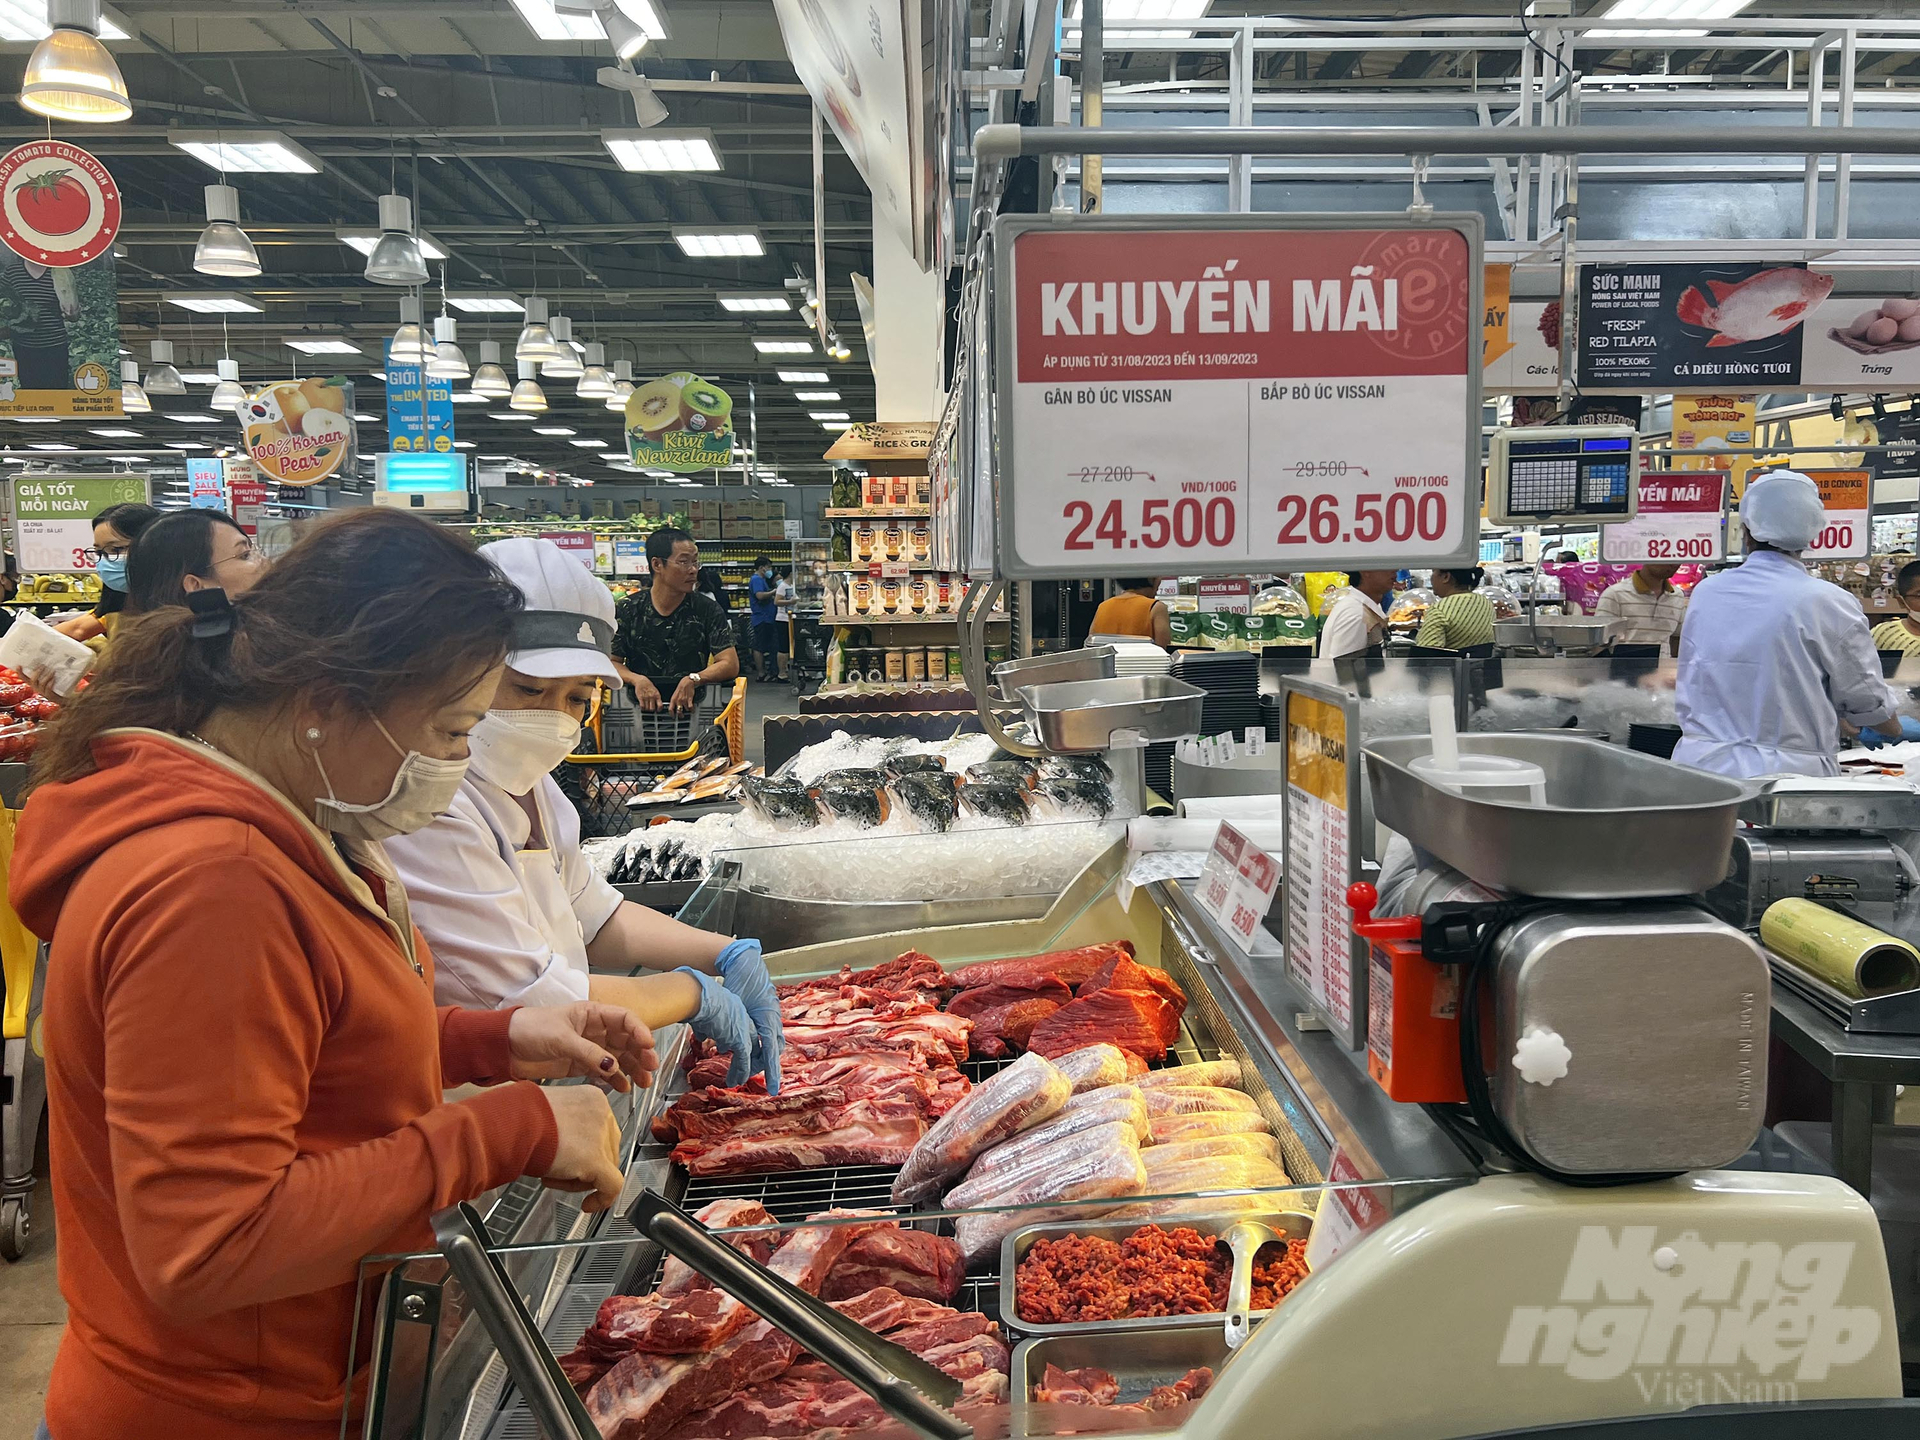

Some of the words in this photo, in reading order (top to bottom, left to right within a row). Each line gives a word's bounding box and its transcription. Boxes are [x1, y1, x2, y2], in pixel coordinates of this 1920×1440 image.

[12, 145, 51, 163] TOMATO
[56, 147, 109, 186] COLLECTION
[1592, 273, 1619, 290] SỨC
[1623, 275, 1660, 291] MẠNH
[1041, 260, 1270, 337] KHUYẾN
[1292, 265, 1398, 332] MÃI
[1589, 337, 1609, 347] RED
[1612, 336, 1657, 347] TILAPIA
[1043, 354, 1057, 368] ÁP
[1060, 355, 1090, 371] DỤNG
[1093, 352, 1107, 367] TỪ
[1111, 354, 1171, 367] 31/08/2023
[1174, 351, 1195, 366] ĐẾN
[1198, 353, 1258, 366] 13/09/2023
[1595, 358, 1616, 367] 100%
[1618, 357, 1650, 366] MEKONG
[1674, 362, 1689, 375] CÁ
[1693, 362, 1722, 375] DIÊU
[1725, 360, 1759, 375] HỒNG
[1763, 362, 1792, 374] TƯƠI
[1860, 364, 1893, 375] Trứng
[1526, 365, 1548, 375] Các
[404, 389, 448, 401] LIMTED
[1044, 388, 1072, 404] GÂN
[1077, 387, 1095, 404] BÒ
[1100, 386, 1118, 404] ÚC
[1122, 389, 1172, 403] VISSAN
[1261, 381, 1287, 400] BẮP
[1292, 383, 1310, 400] BÒ
[1314, 382, 1332, 399] ÚC
[1337, 385, 1385, 399] VISSAN
[252, 438, 290, 460] 100%
[292, 430, 345, 451] Korean
[663, 431, 706, 449] Kiwi
[873, 440, 898, 448] RICE
[899, 440, 909, 448] &
[280, 454, 322, 475] Pear
[635, 448, 730, 466] Newzeland
[1080, 466, 1133, 483] 27.200
[1295, 461, 1347, 477] 29.500
[19, 483, 44, 496] GIÁ
[47, 481, 76, 496] TỐT
[195, 481, 217, 489] SALE
[1180, 480, 1237, 494] VND/100G
[1394, 476, 1449, 488] VND/100G
[1671, 484, 1701, 502] MÃI
[20, 496, 48, 511] MỖI
[51, 497, 90, 511] NGÀY
[1063, 497, 1236, 551] 24.500
[1277, 491, 1447, 545] 26.500
[1648, 539, 1713, 558] 82.900
[1200, 583, 1227, 591] KHUYẾN
[1228, 583, 1241, 591] MÃI
[1738, 1038, 1753, 1052] IN
[1736, 1060, 1752, 1111] TAIWAN
